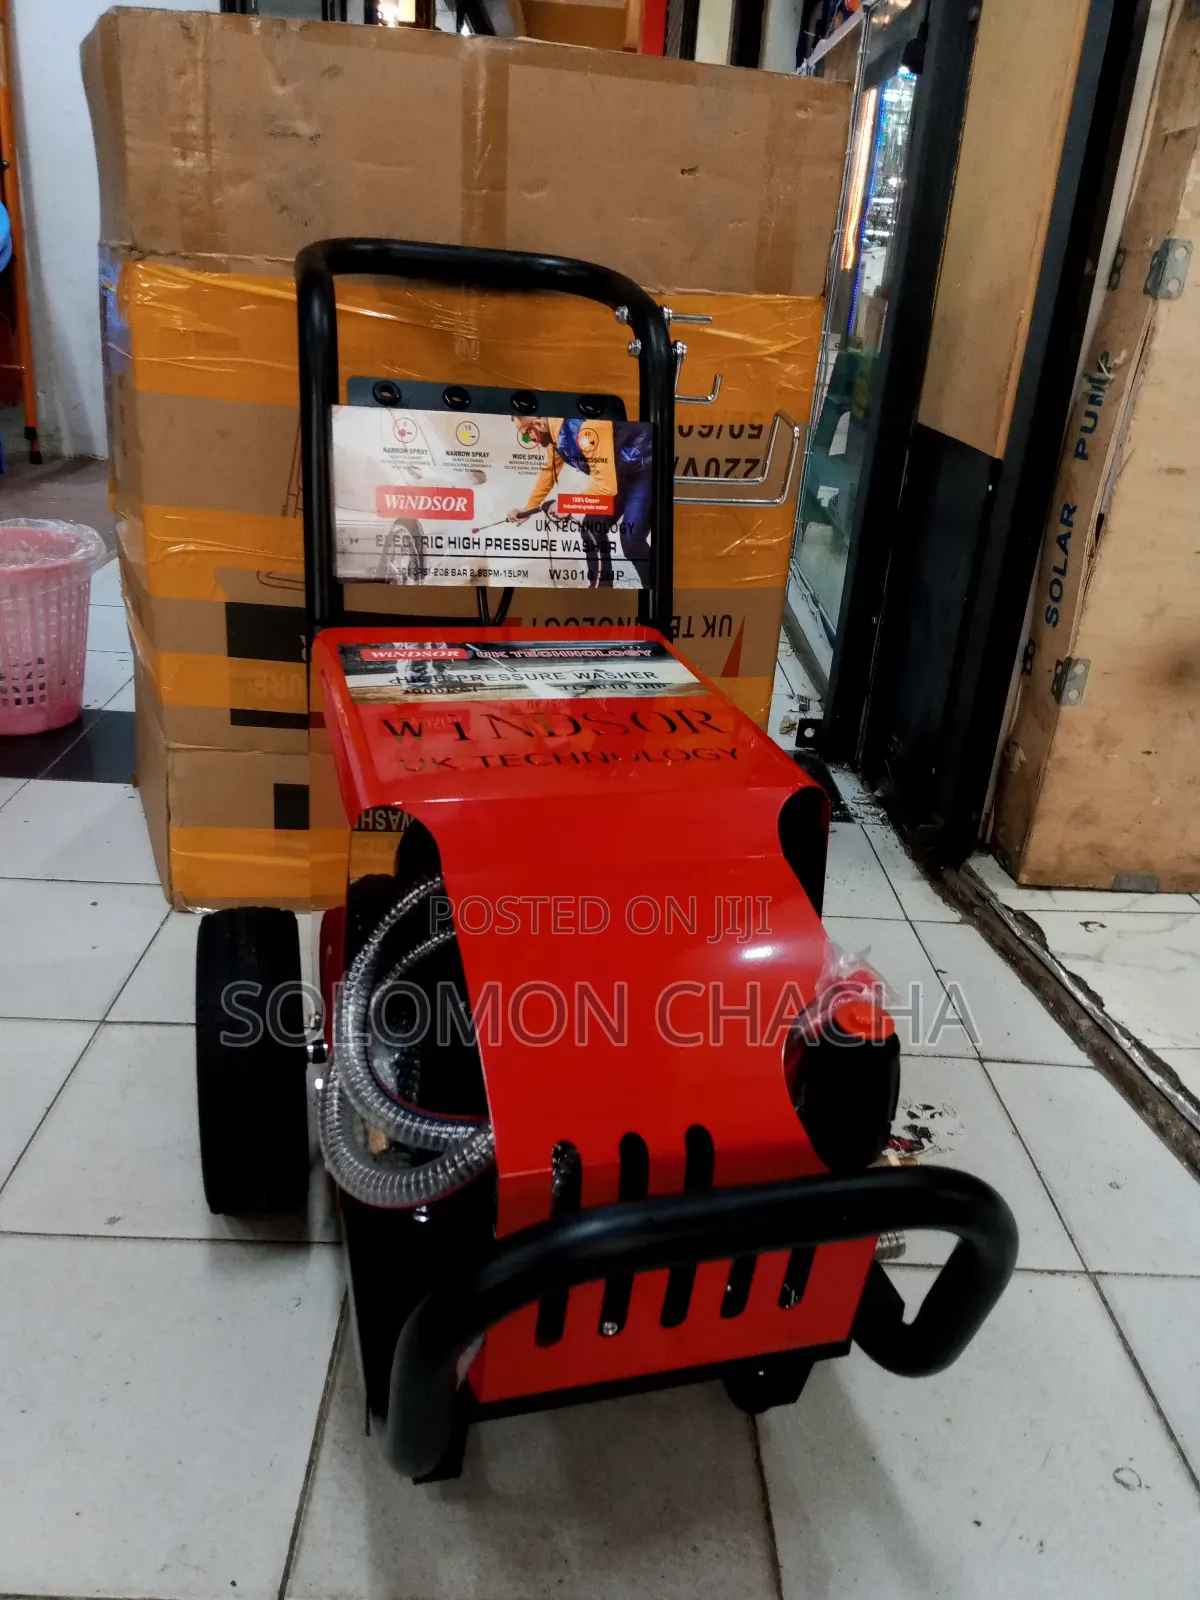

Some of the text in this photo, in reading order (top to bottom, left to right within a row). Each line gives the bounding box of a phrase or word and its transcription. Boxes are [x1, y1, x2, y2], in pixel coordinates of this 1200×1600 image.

[536, 520, 635, 535] UK TECHNOLOGY
[448, 536, 481, 549] HIGH
[485, 538, 557, 552] PRESSURE
[561, 540, 617, 553] WASHER
[451, 569, 468, 577] BAR
[1045, 503, 1078, 628] SOLAR
[702, 614, 733, 638] UK
[476, 650, 507, 658] UK
[509, 650, 652, 658] TECHNOLOGY
[457, 672, 566, 683] PRESSURE
[573, 671, 659, 681] WASHER
[400, 747, 742, 773] UK TECHNOLOGY
[354, 809, 416, 832] WASH
